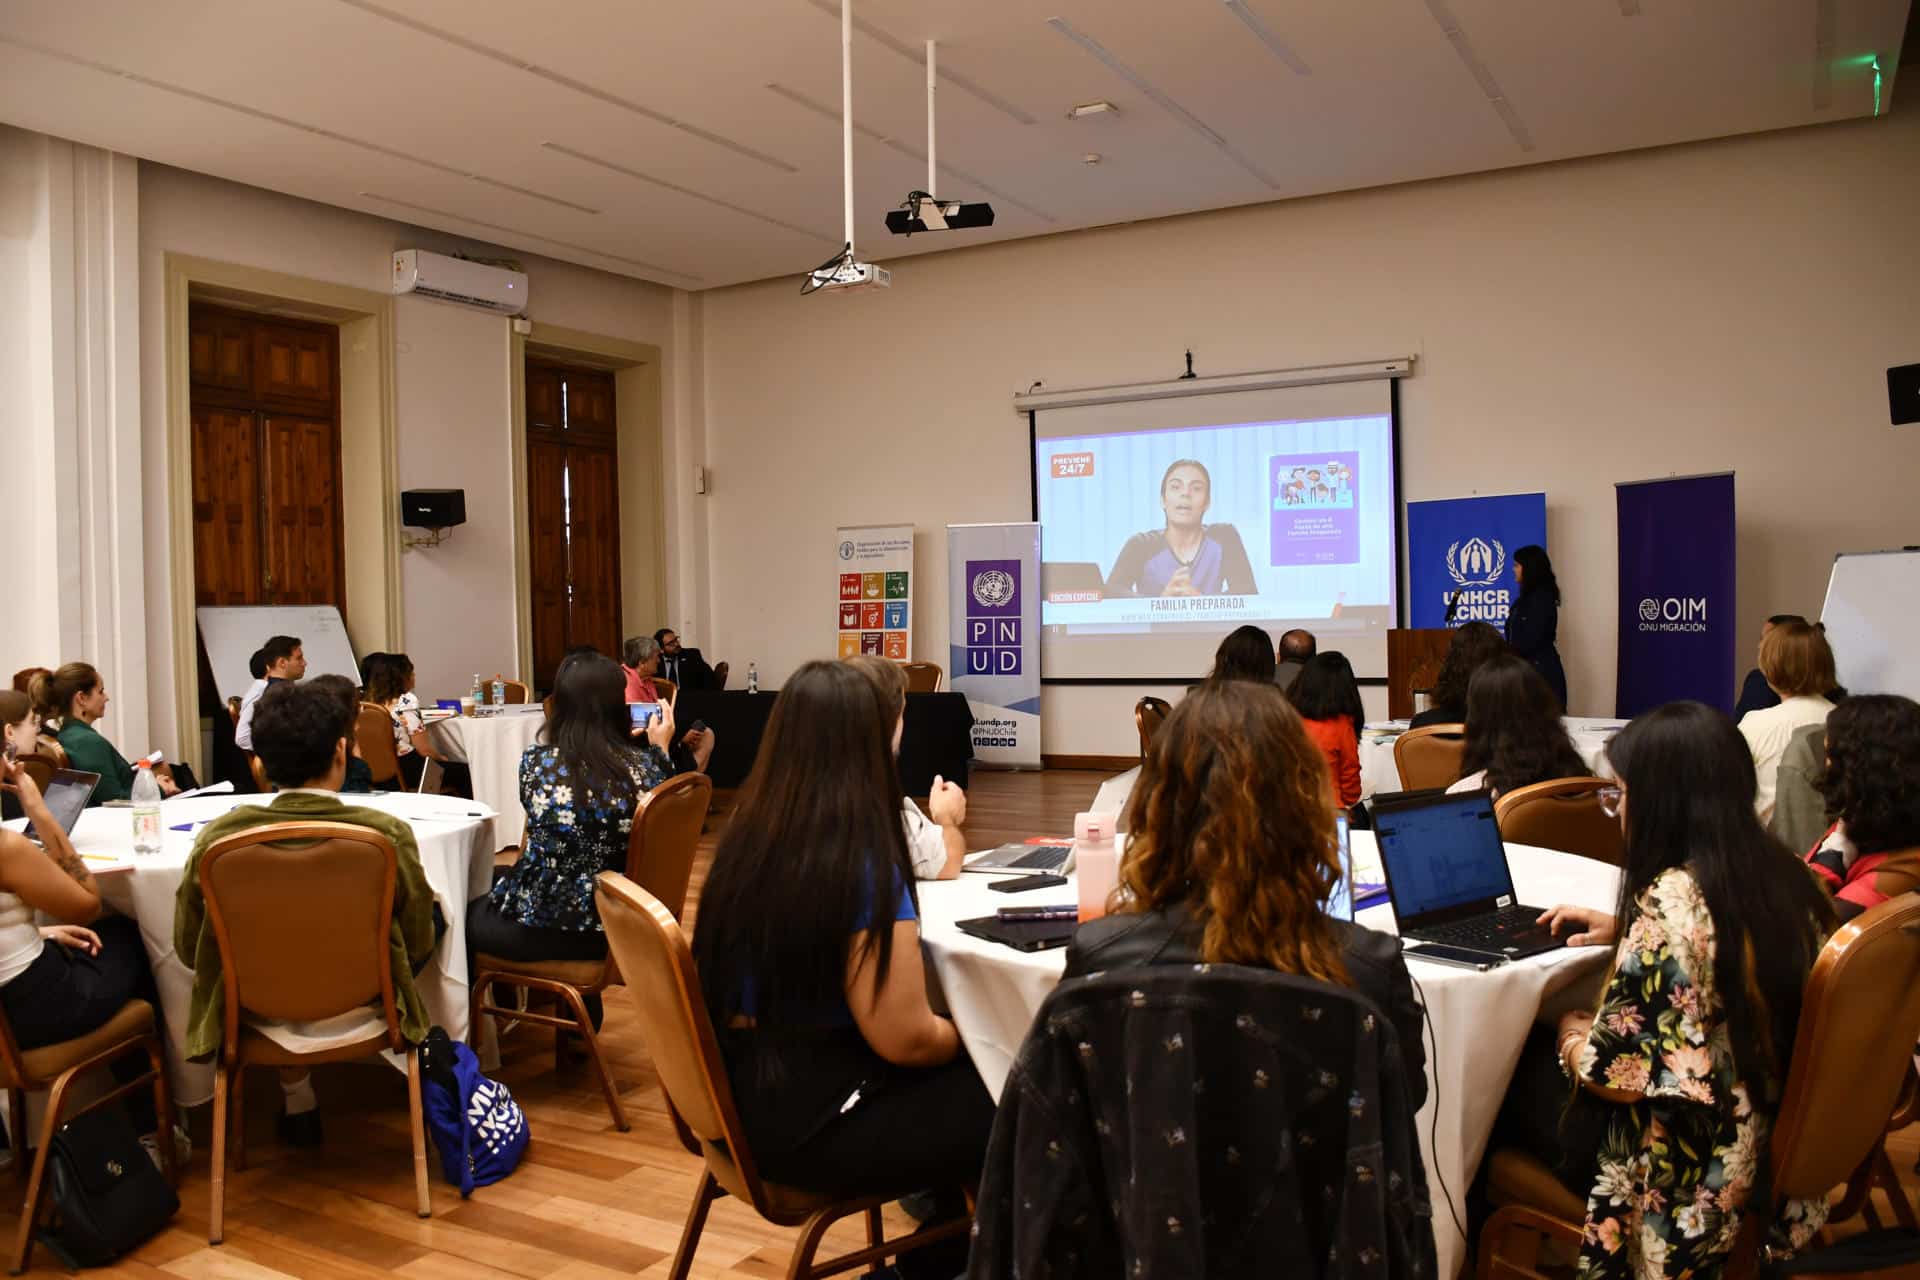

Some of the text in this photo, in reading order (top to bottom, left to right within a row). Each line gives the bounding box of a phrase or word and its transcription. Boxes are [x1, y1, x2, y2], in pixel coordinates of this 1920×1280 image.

[1059, 463, 1086, 475] 24/7
[1150, 597, 1246, 611] FAMILIA PREPARADA
[1443, 590, 1510, 606] UNHCR
[1453, 604, 1511, 621] CNUR
[1663, 598, 1706, 621] OIM
[1639, 621, 1706, 632] ONU MIGRACIÓN
